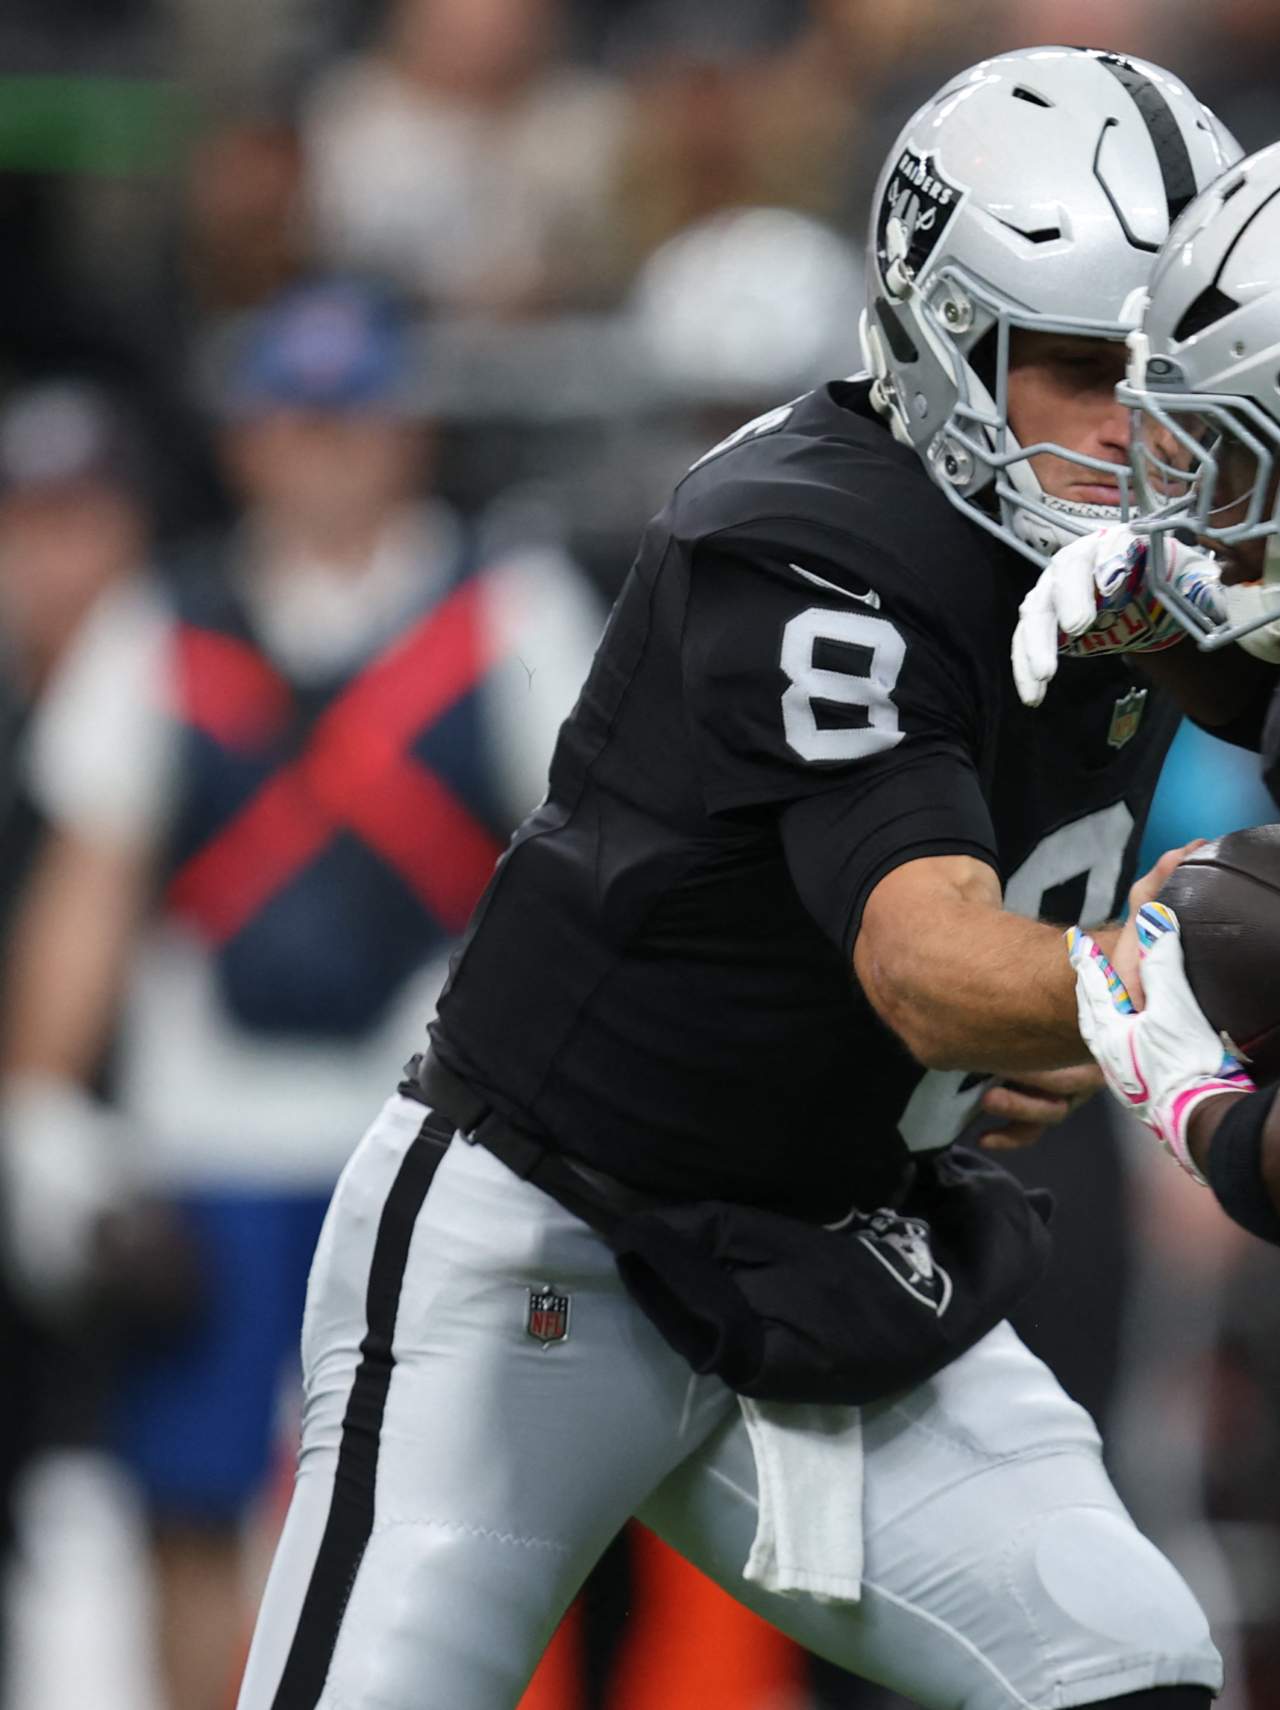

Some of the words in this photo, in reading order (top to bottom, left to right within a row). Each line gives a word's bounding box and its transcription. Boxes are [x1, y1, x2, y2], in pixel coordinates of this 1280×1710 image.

[899, 154, 953, 204] RAIDERS
[780, 607, 908, 762] 8
[532, 1311, 565, 1338] NFL
